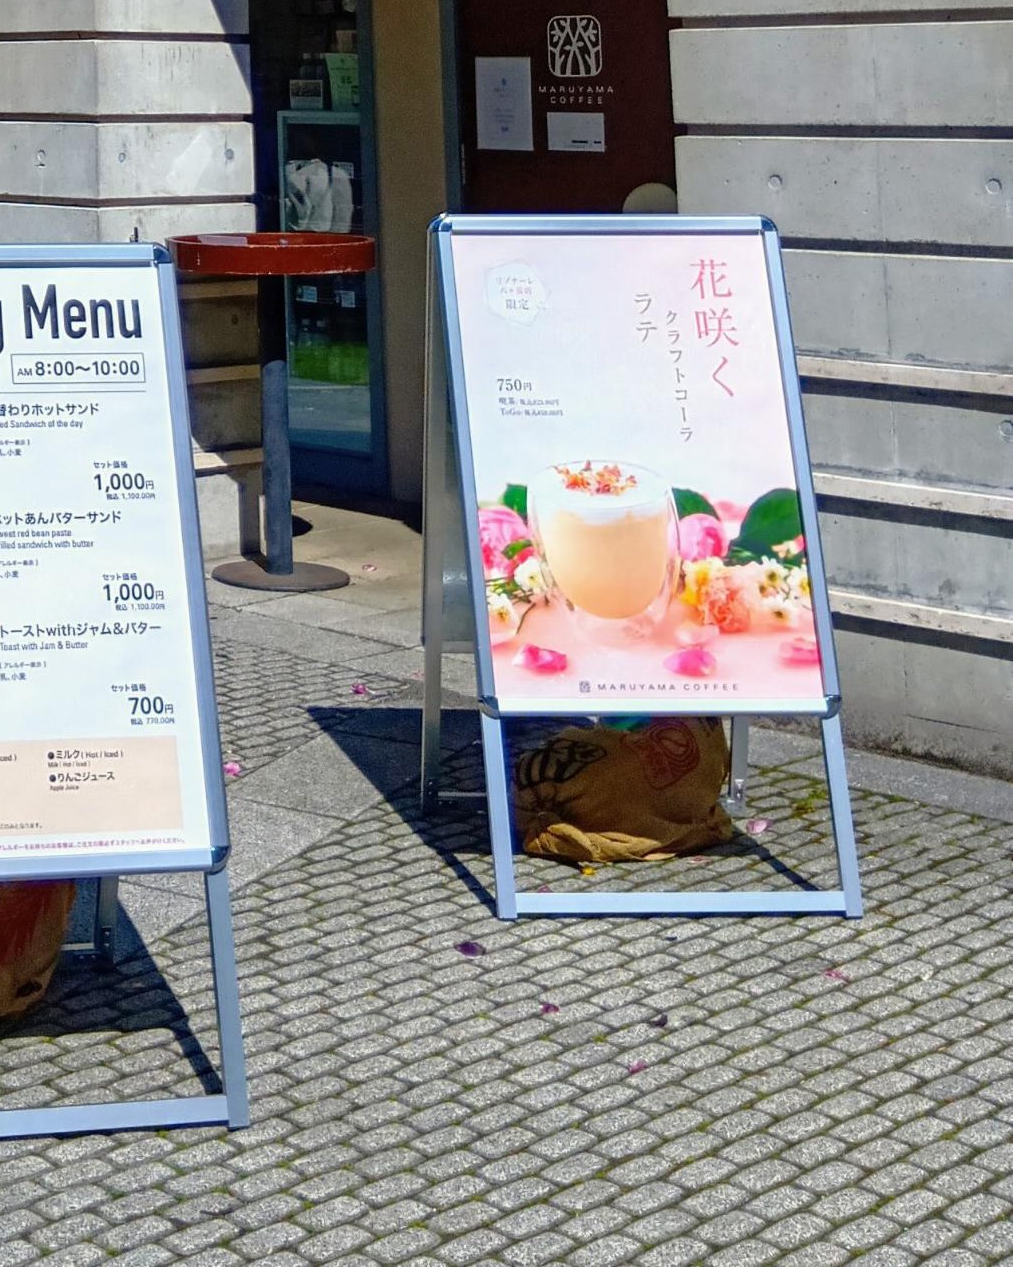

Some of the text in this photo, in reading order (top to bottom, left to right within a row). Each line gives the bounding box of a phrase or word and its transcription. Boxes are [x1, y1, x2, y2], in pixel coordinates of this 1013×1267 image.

[550, 96, 603, 104] COFFEE
[21, 283, 143, 339] Menu
[634, 293, 658, 343] ラテ
[689, 259, 740, 398] 花咲く
[17, 368, 33, 377] AM
[666, 310, 693, 442] クラフトコーラ
[497, 378, 532, 392] 750円
[10, 419, 47, 429] Sandwich
[48, 419, 55, 428] of
[56, 419, 69, 428] the
[70, 419, 83, 429] day
[93, 460, 128, 469] セット価格
[93, 473, 154, 493] 1,000円
[17, 529, 30, 538] red
[31, 529, 50, 538] bean
[51, 529, 72, 539] paste
[17, 540, 53, 550] sandwich
[54, 540, 71, 549] with
[72, 540, 94, 548] butter
[102, 572, 138, 581] セット価格
[102, 583, 165, 603] 1,000円
[0, 621, 162, 638] トーストwithジャム&バター
[0, 642, 20, 651] Toast
[22, 641, 38, 650] with
[39, 641, 56, 650] Jam
[65, 640, 88, 649] Butter
[111, 683, 147, 692] セット価格
[597, 683, 738, 691] MARUYAMA COFFEE
[128, 696, 174, 715] 700円
[57, 771, 115, 782] りんごジュース
